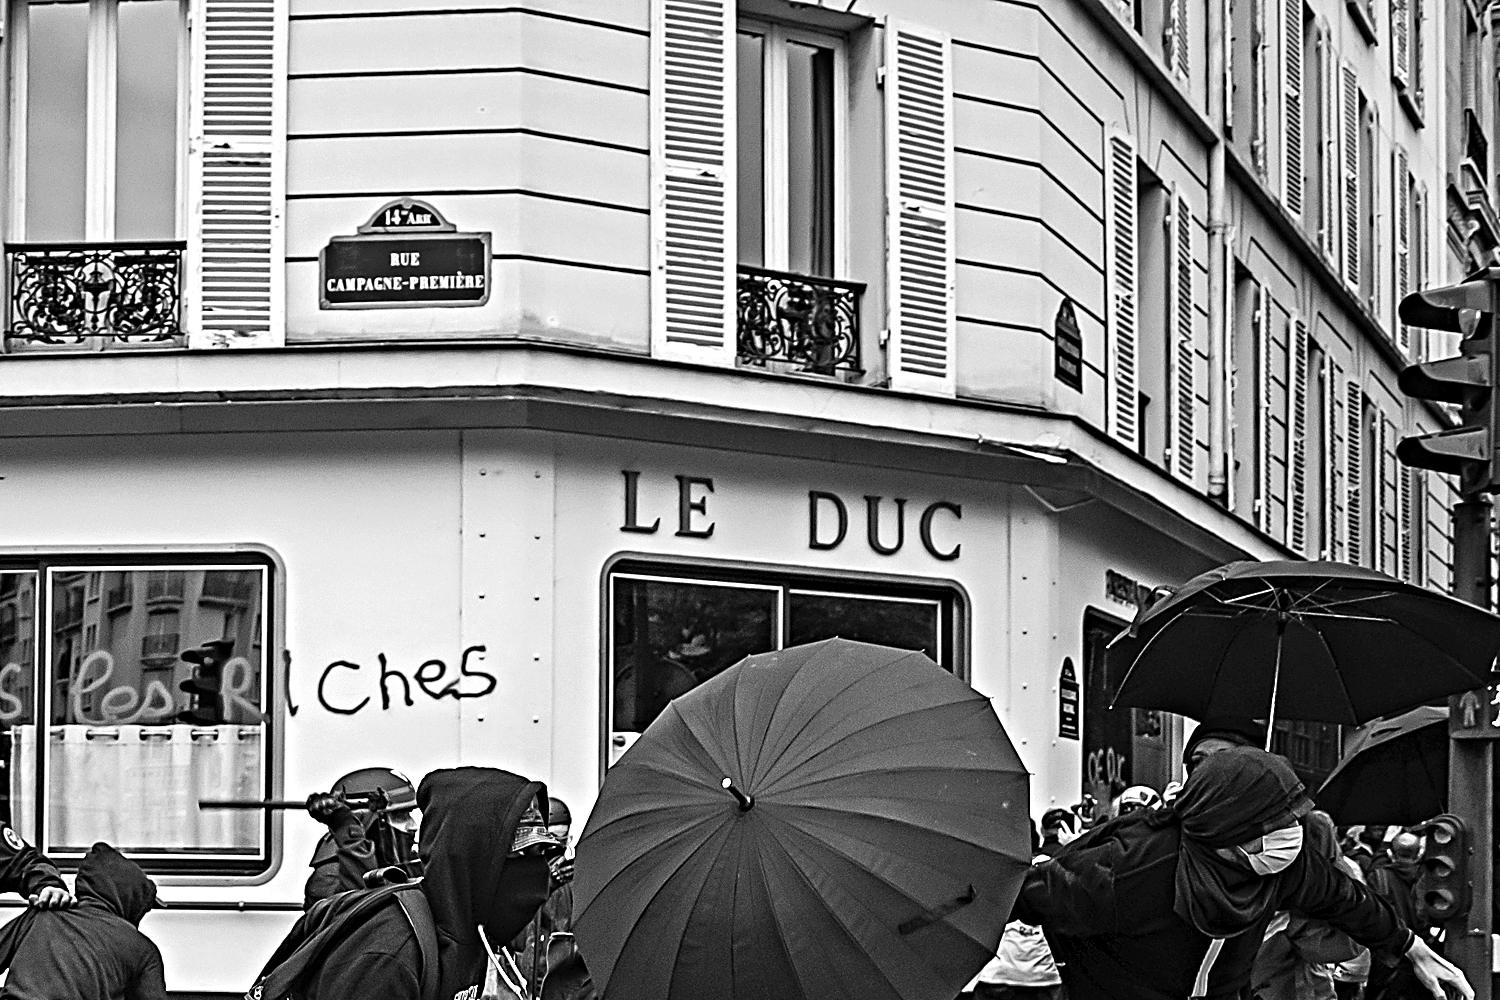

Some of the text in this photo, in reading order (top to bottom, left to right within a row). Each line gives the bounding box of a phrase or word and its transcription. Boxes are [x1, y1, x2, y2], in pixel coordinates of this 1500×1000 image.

[326, 271, 485, 292] CAMPAGNE-PREMIÈRE
[390, 252, 420, 267] RUE
[619, 469, 963, 561] LE DUC
[74, 649, 175, 726] les
